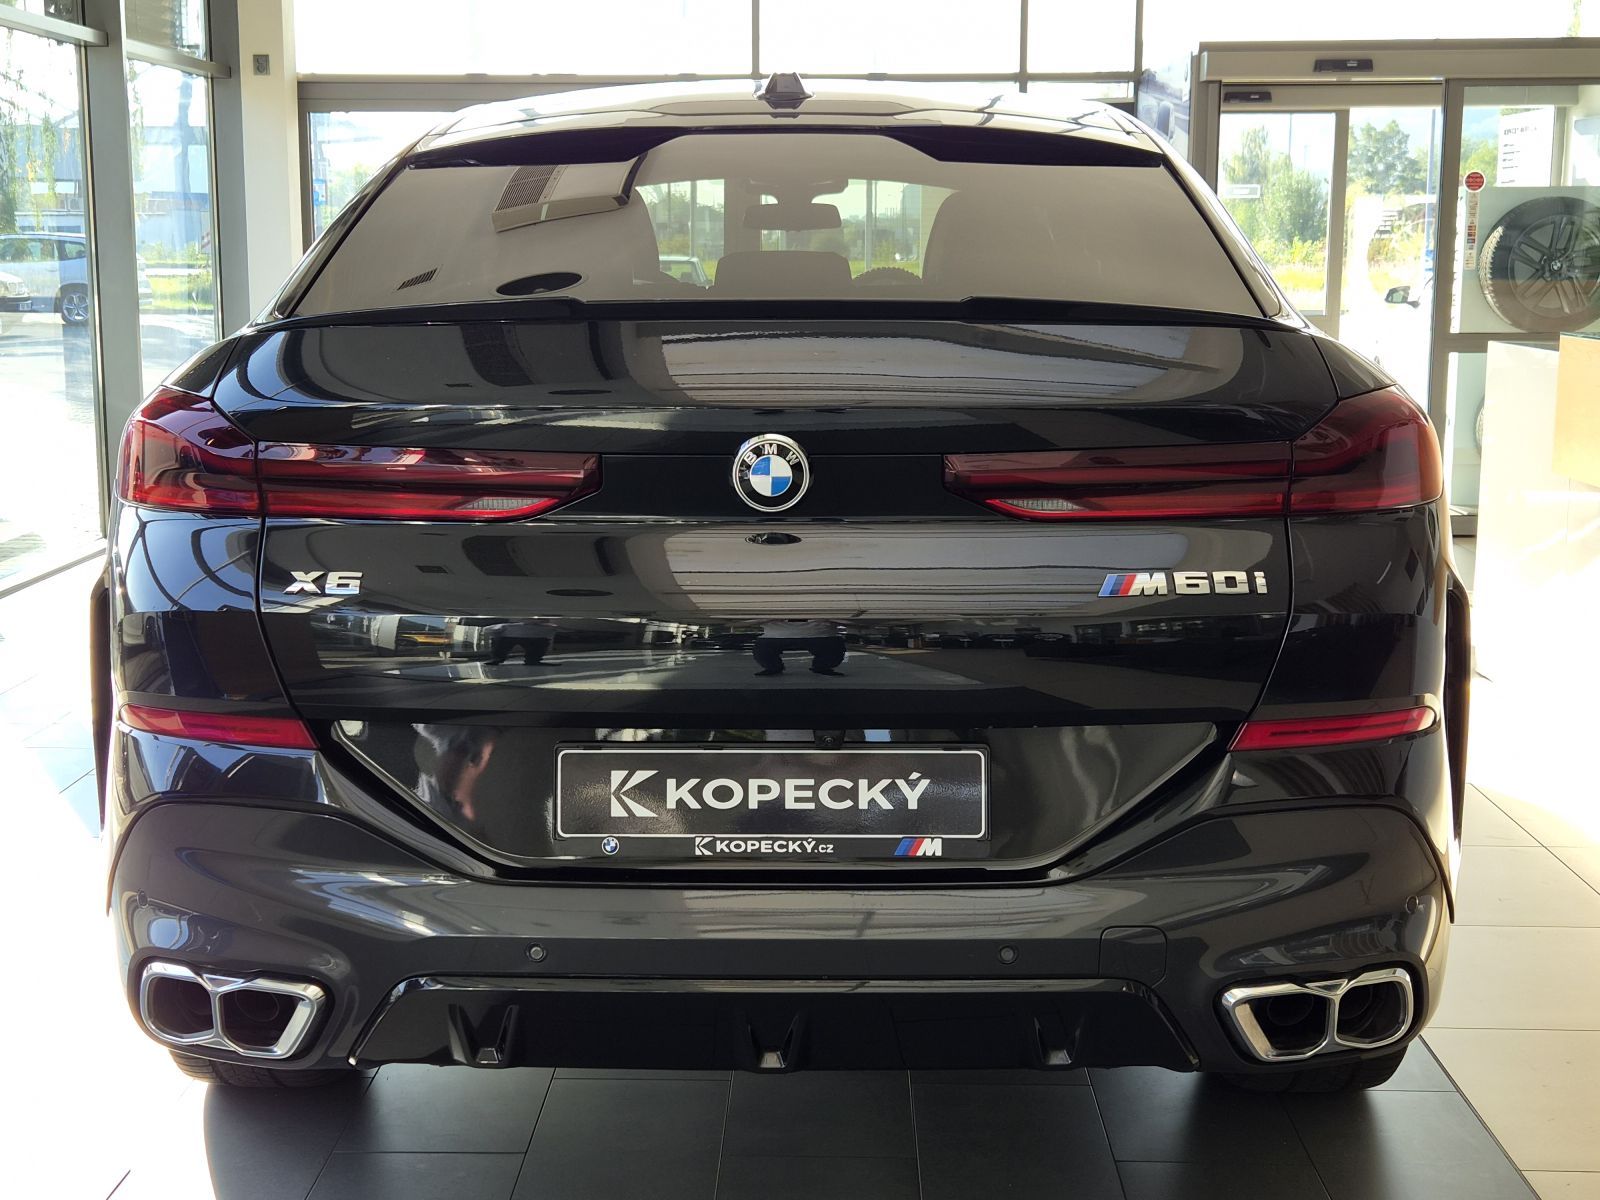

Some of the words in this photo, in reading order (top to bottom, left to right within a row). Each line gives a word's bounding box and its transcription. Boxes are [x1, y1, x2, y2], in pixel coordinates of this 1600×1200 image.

[743, 443, 800, 466] BMW
[282, 571, 364, 595] X6
[665, 771, 931, 810] KOPECKÝ
